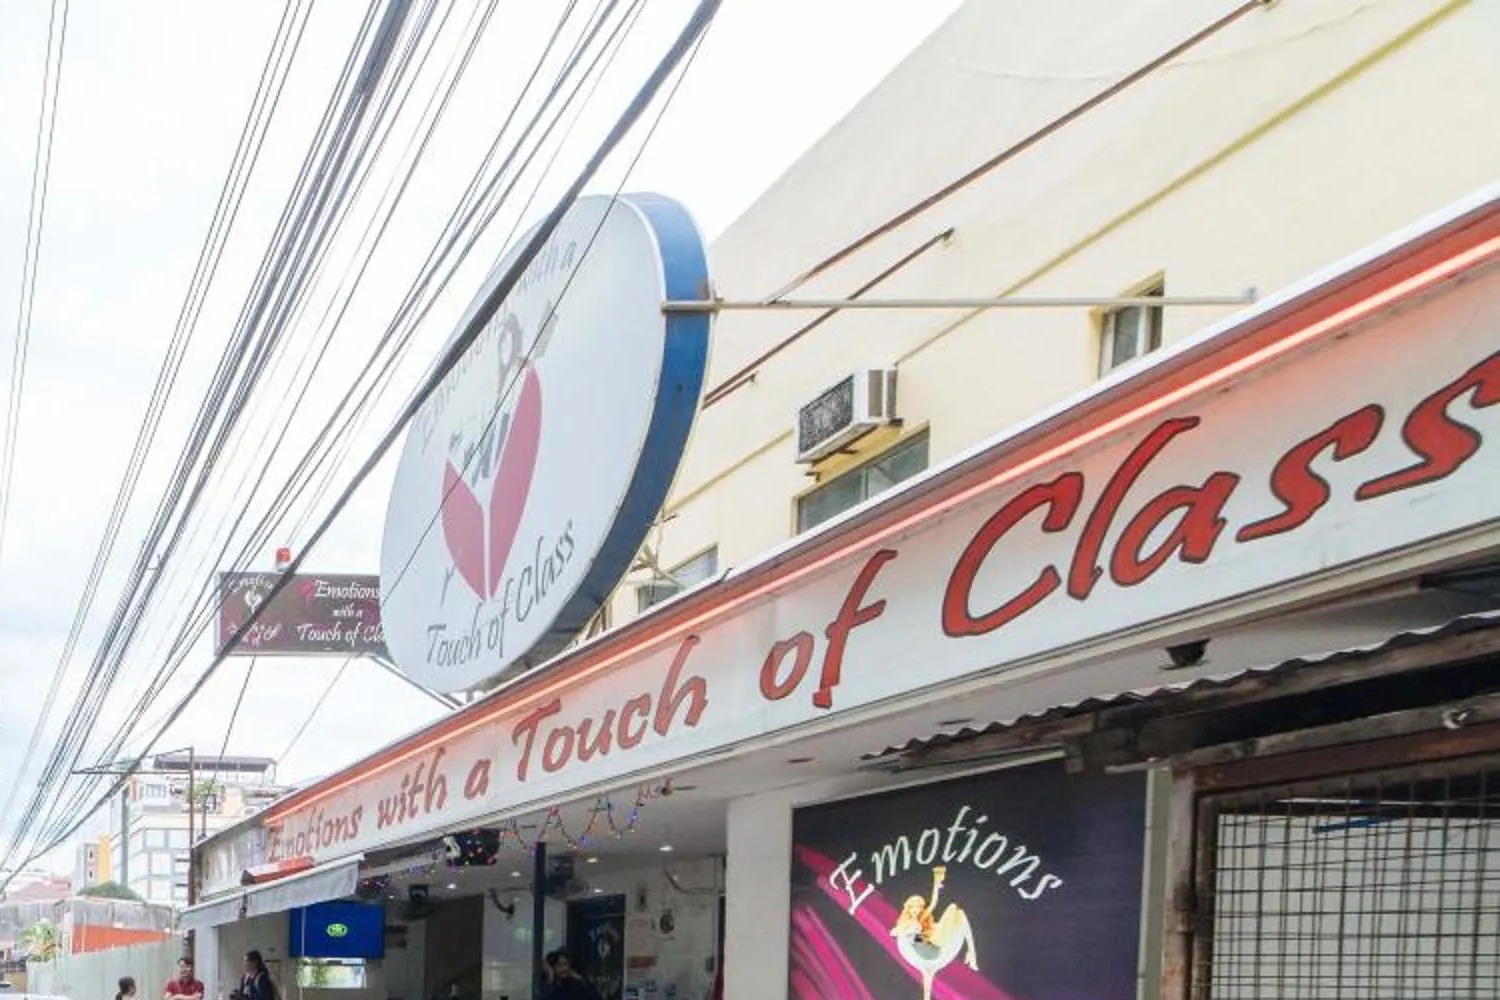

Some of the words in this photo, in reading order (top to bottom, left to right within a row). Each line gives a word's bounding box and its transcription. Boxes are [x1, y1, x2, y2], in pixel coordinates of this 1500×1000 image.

[267, 804, 363, 863] Emotions
[377, 747, 447, 830] with
[464, 757, 492, 800] a
[511, 633, 708, 782] Touch
[759, 549, 898, 709] of
[941, 350, 1500, 638] Class
[296, 621, 341, 641] Touch
[345, 621, 363, 648] of
[427, 601, 483, 667] Touch
[487, 578, 514, 659] of
[515, 518, 575, 622] Class
[829, 805, 1064, 915] Emotions
